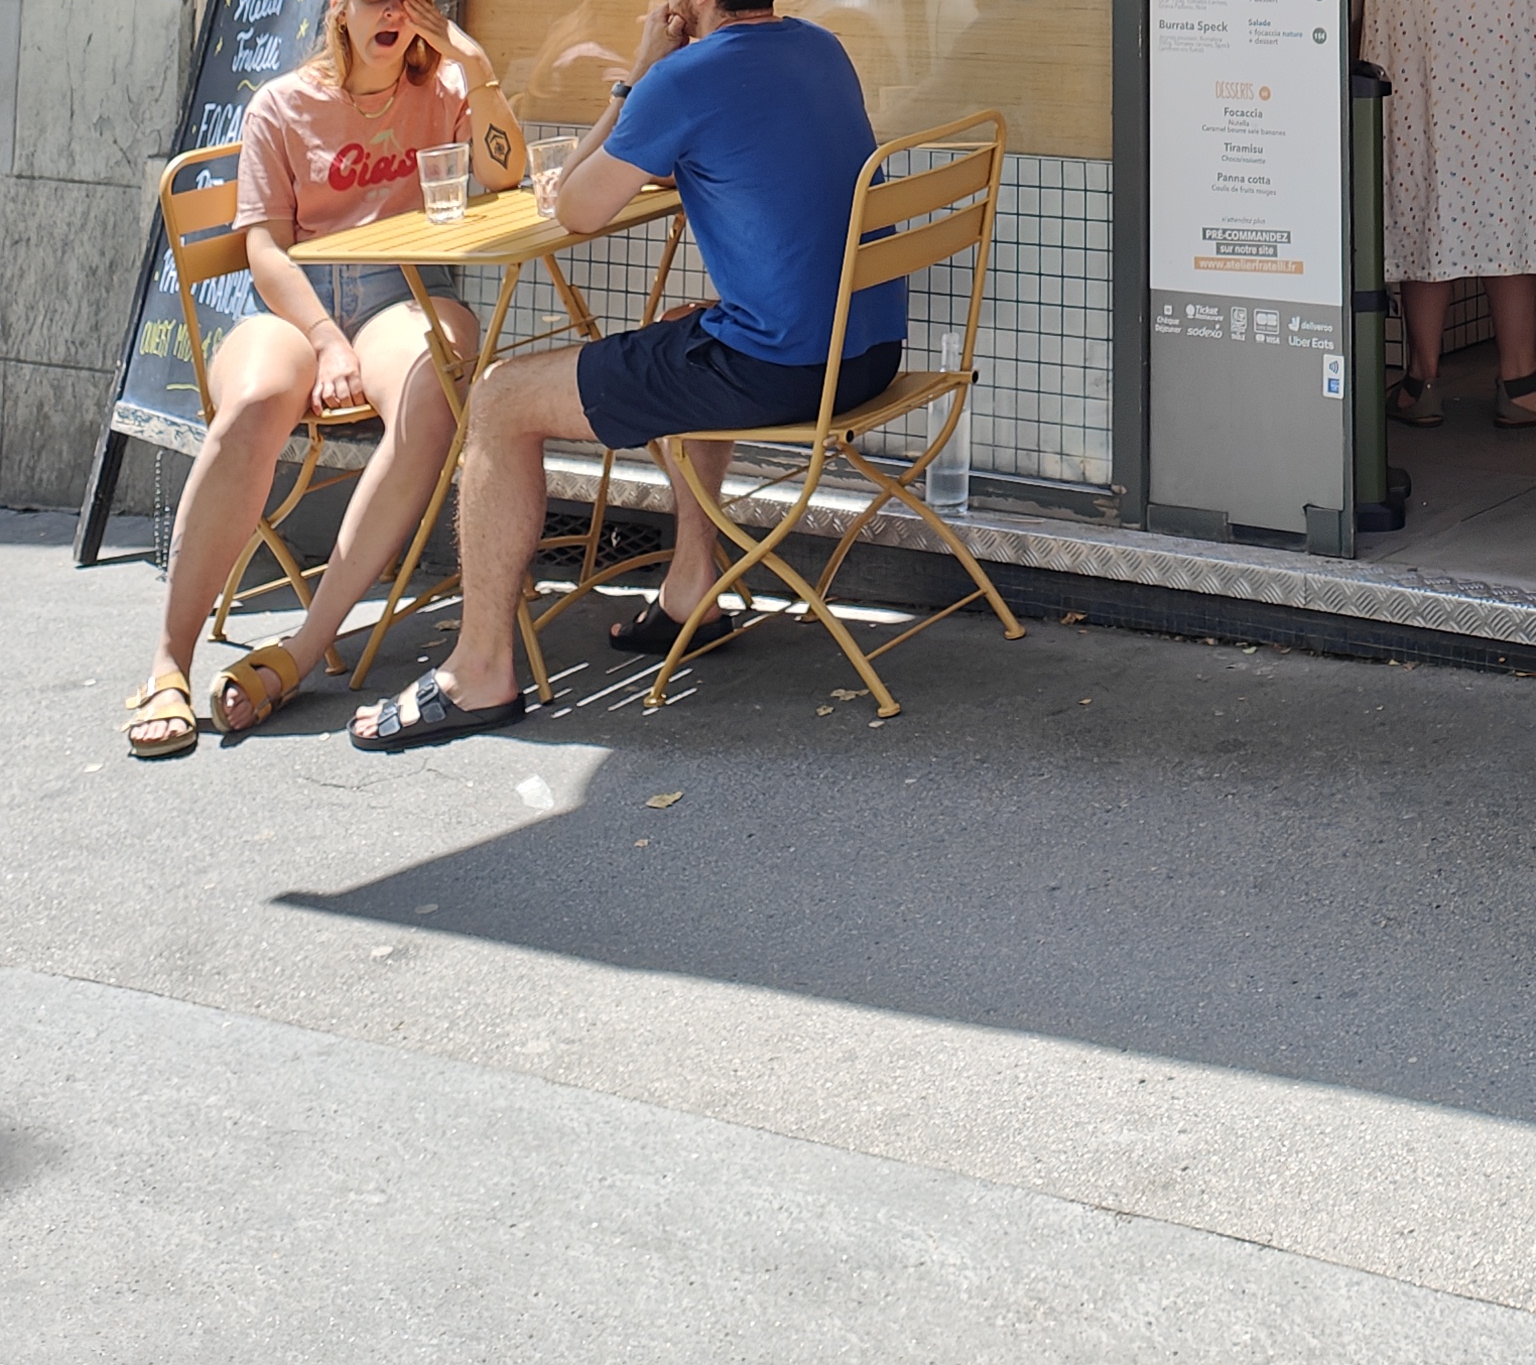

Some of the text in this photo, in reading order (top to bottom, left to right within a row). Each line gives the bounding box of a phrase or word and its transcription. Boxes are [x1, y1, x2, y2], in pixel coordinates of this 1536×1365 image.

[1159, 20, 1229, 34] Burrata Speck
[1254, 29, 1281, 38] focaccia
[1254, 37, 1278, 45] dessert
[1215, 81, 1254, 100] DESSERTS
[1223, 107, 1263, 118] Focaccia
[1223, 142, 1263, 154] Tiramisu
[327, 142, 419, 192] Ciao
[1217, 172, 1271, 185] Panna cotta
[1206, 229, 1289, 243] PRÉ-COMMANDEZ
[1220, 245, 1274, 255] sur notre site
[1196, 305, 1219, 316] Ticket
[1187, 326, 1223, 339] sodexo
[1288, 336, 1334, 350] Uber Eats
